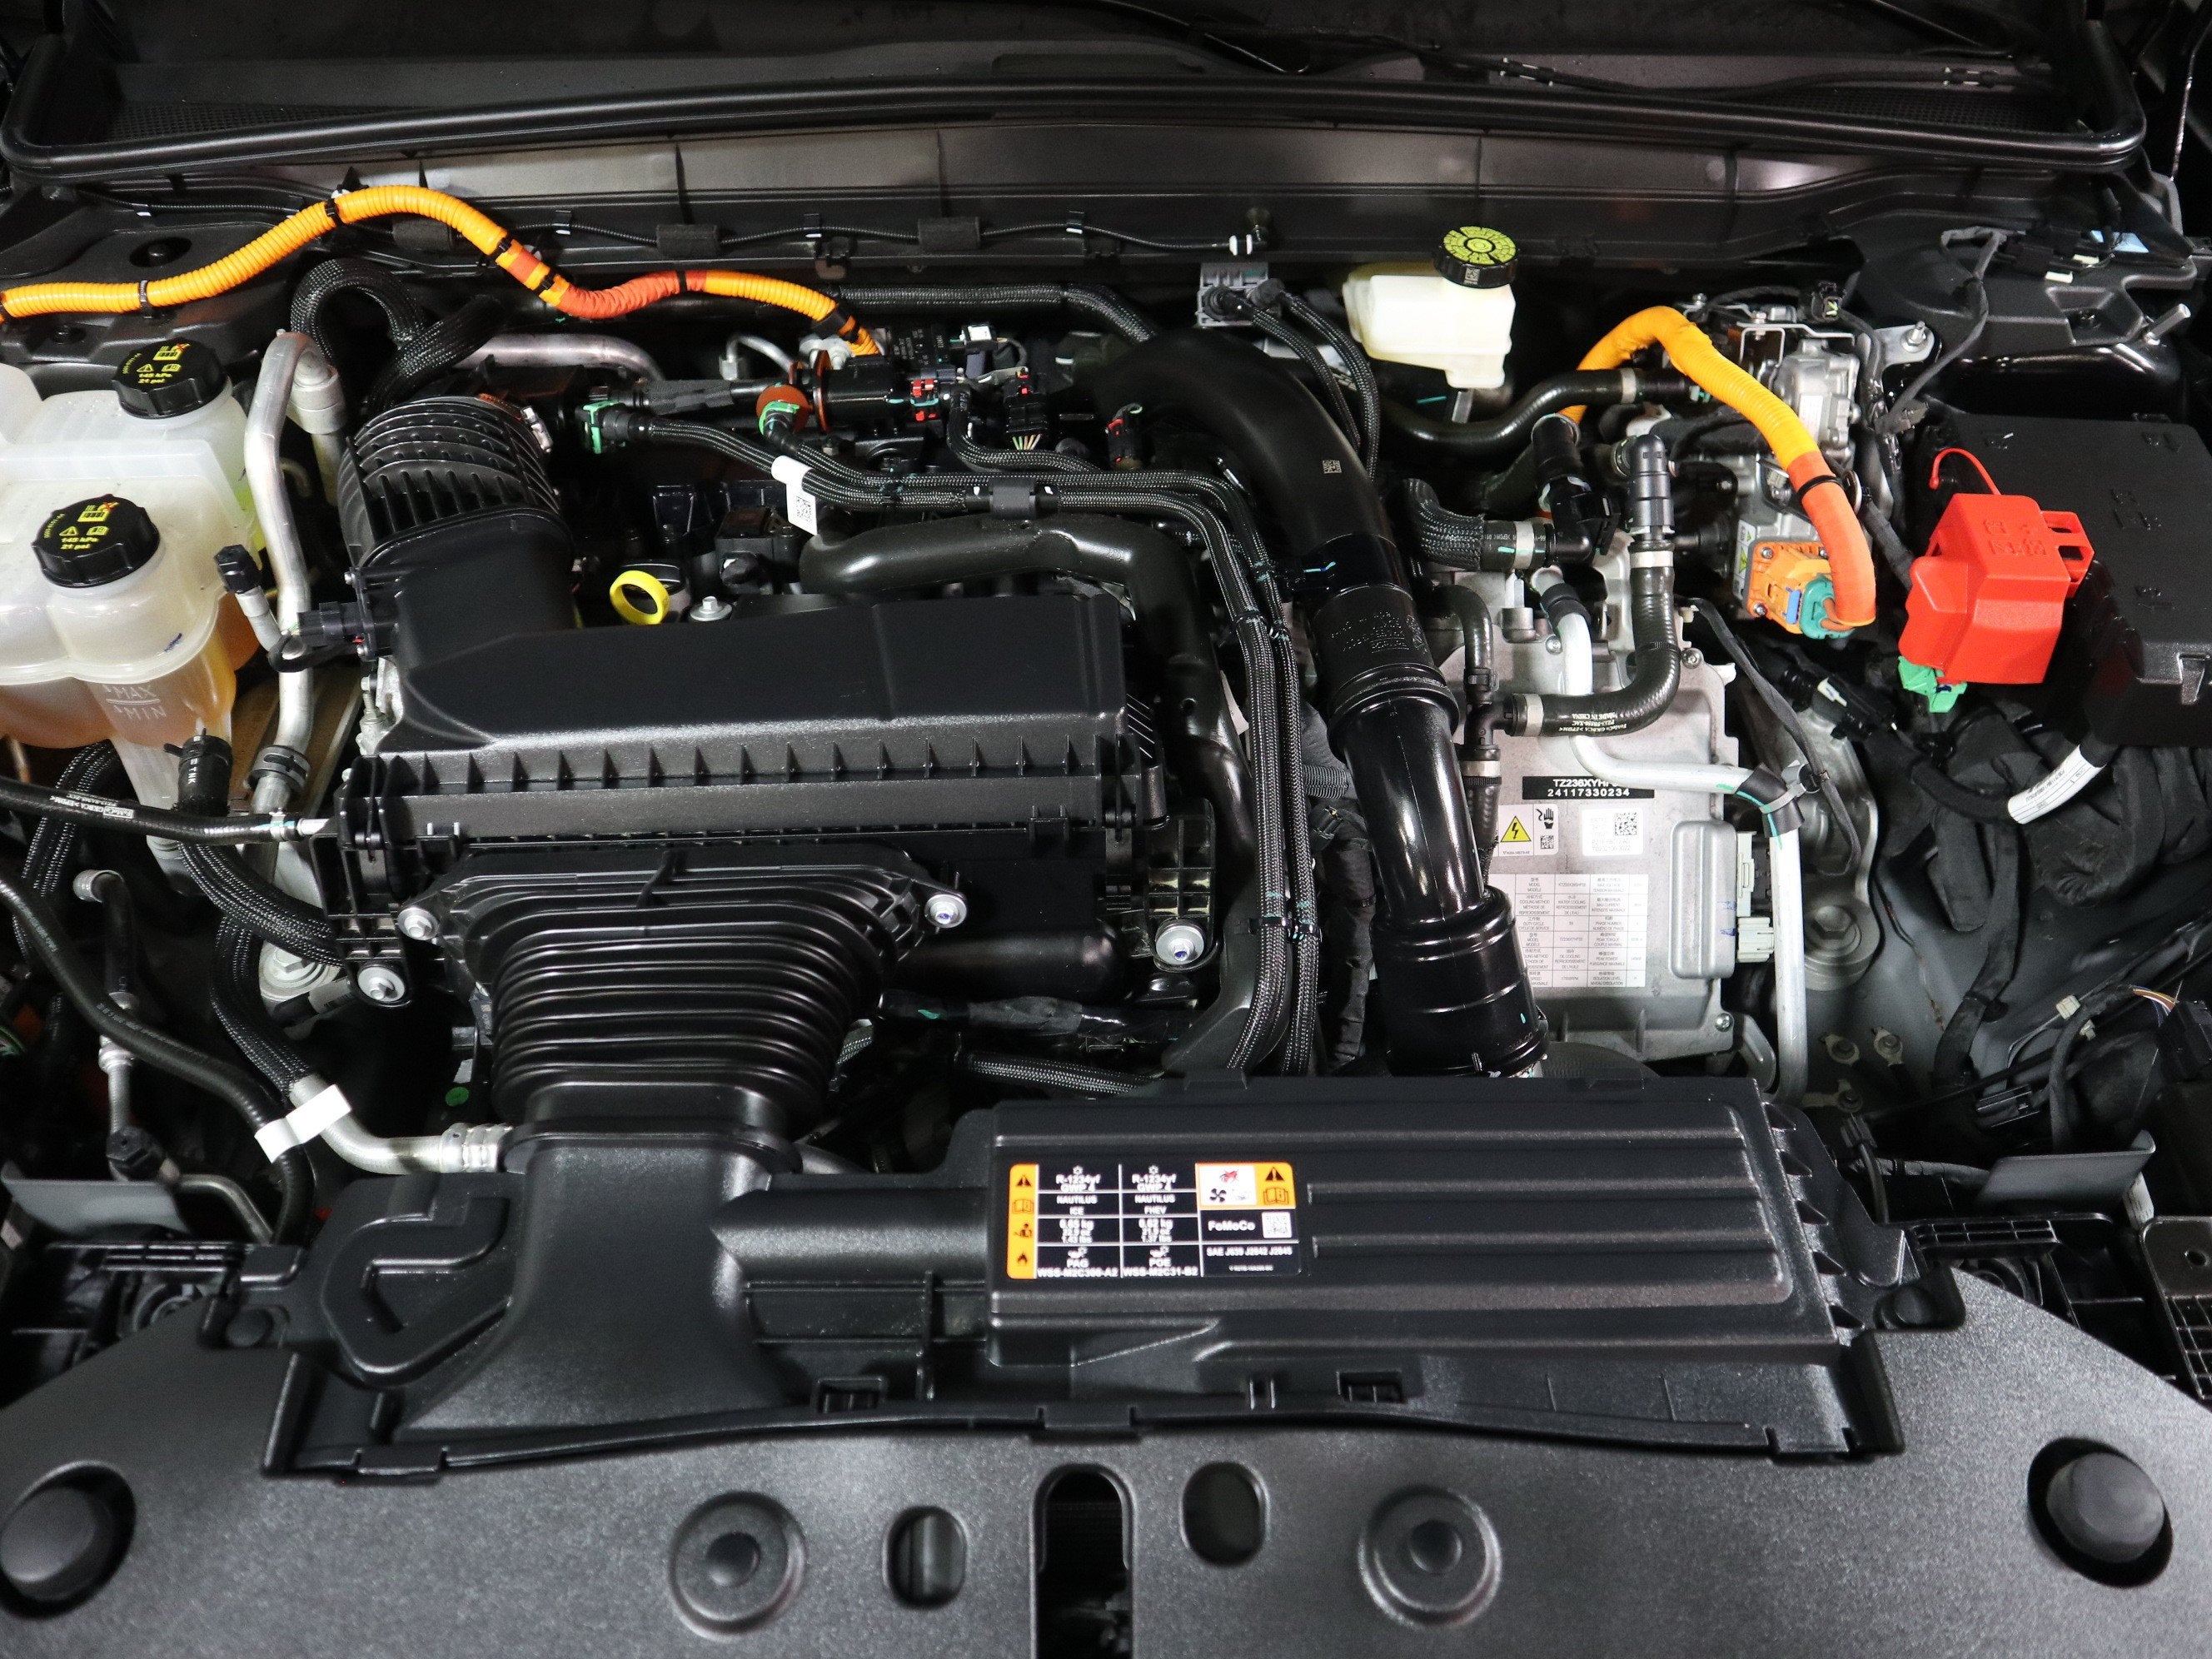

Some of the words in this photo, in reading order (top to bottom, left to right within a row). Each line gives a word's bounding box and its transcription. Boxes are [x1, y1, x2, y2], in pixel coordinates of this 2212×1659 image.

[112, 686, 157, 699] MAX
[123, 707, 167, 720] MIN
[1547, 788, 1630, 797] 24117330234
[1055, 1174, 1101, 1184] R-1234yf
[1131, 1173, 1177, 1184] R-1234yf
[1061, 1183, 1087, 1192] GWP
[1137, 1183, 1163, 1191] GWP
[1056, 1194, 1098, 1204] NAUTILUS
[1134, 1194, 1176, 1203] NAUTILUS
[1069, 1206, 1084, 1215] ICE
[1144, 1205, 1168, 1214] FHEV
[1081, 1218, 1094, 1231] kg
[1160, 1218, 1173, 1230] kg
[1208, 1219, 1256, 1231] FoMoCo
[1206, 1247, 1224, 1256] SAE
[1067, 1258, 1089, 1268] PAG
[1149, 1258, 1171, 1267] POE
